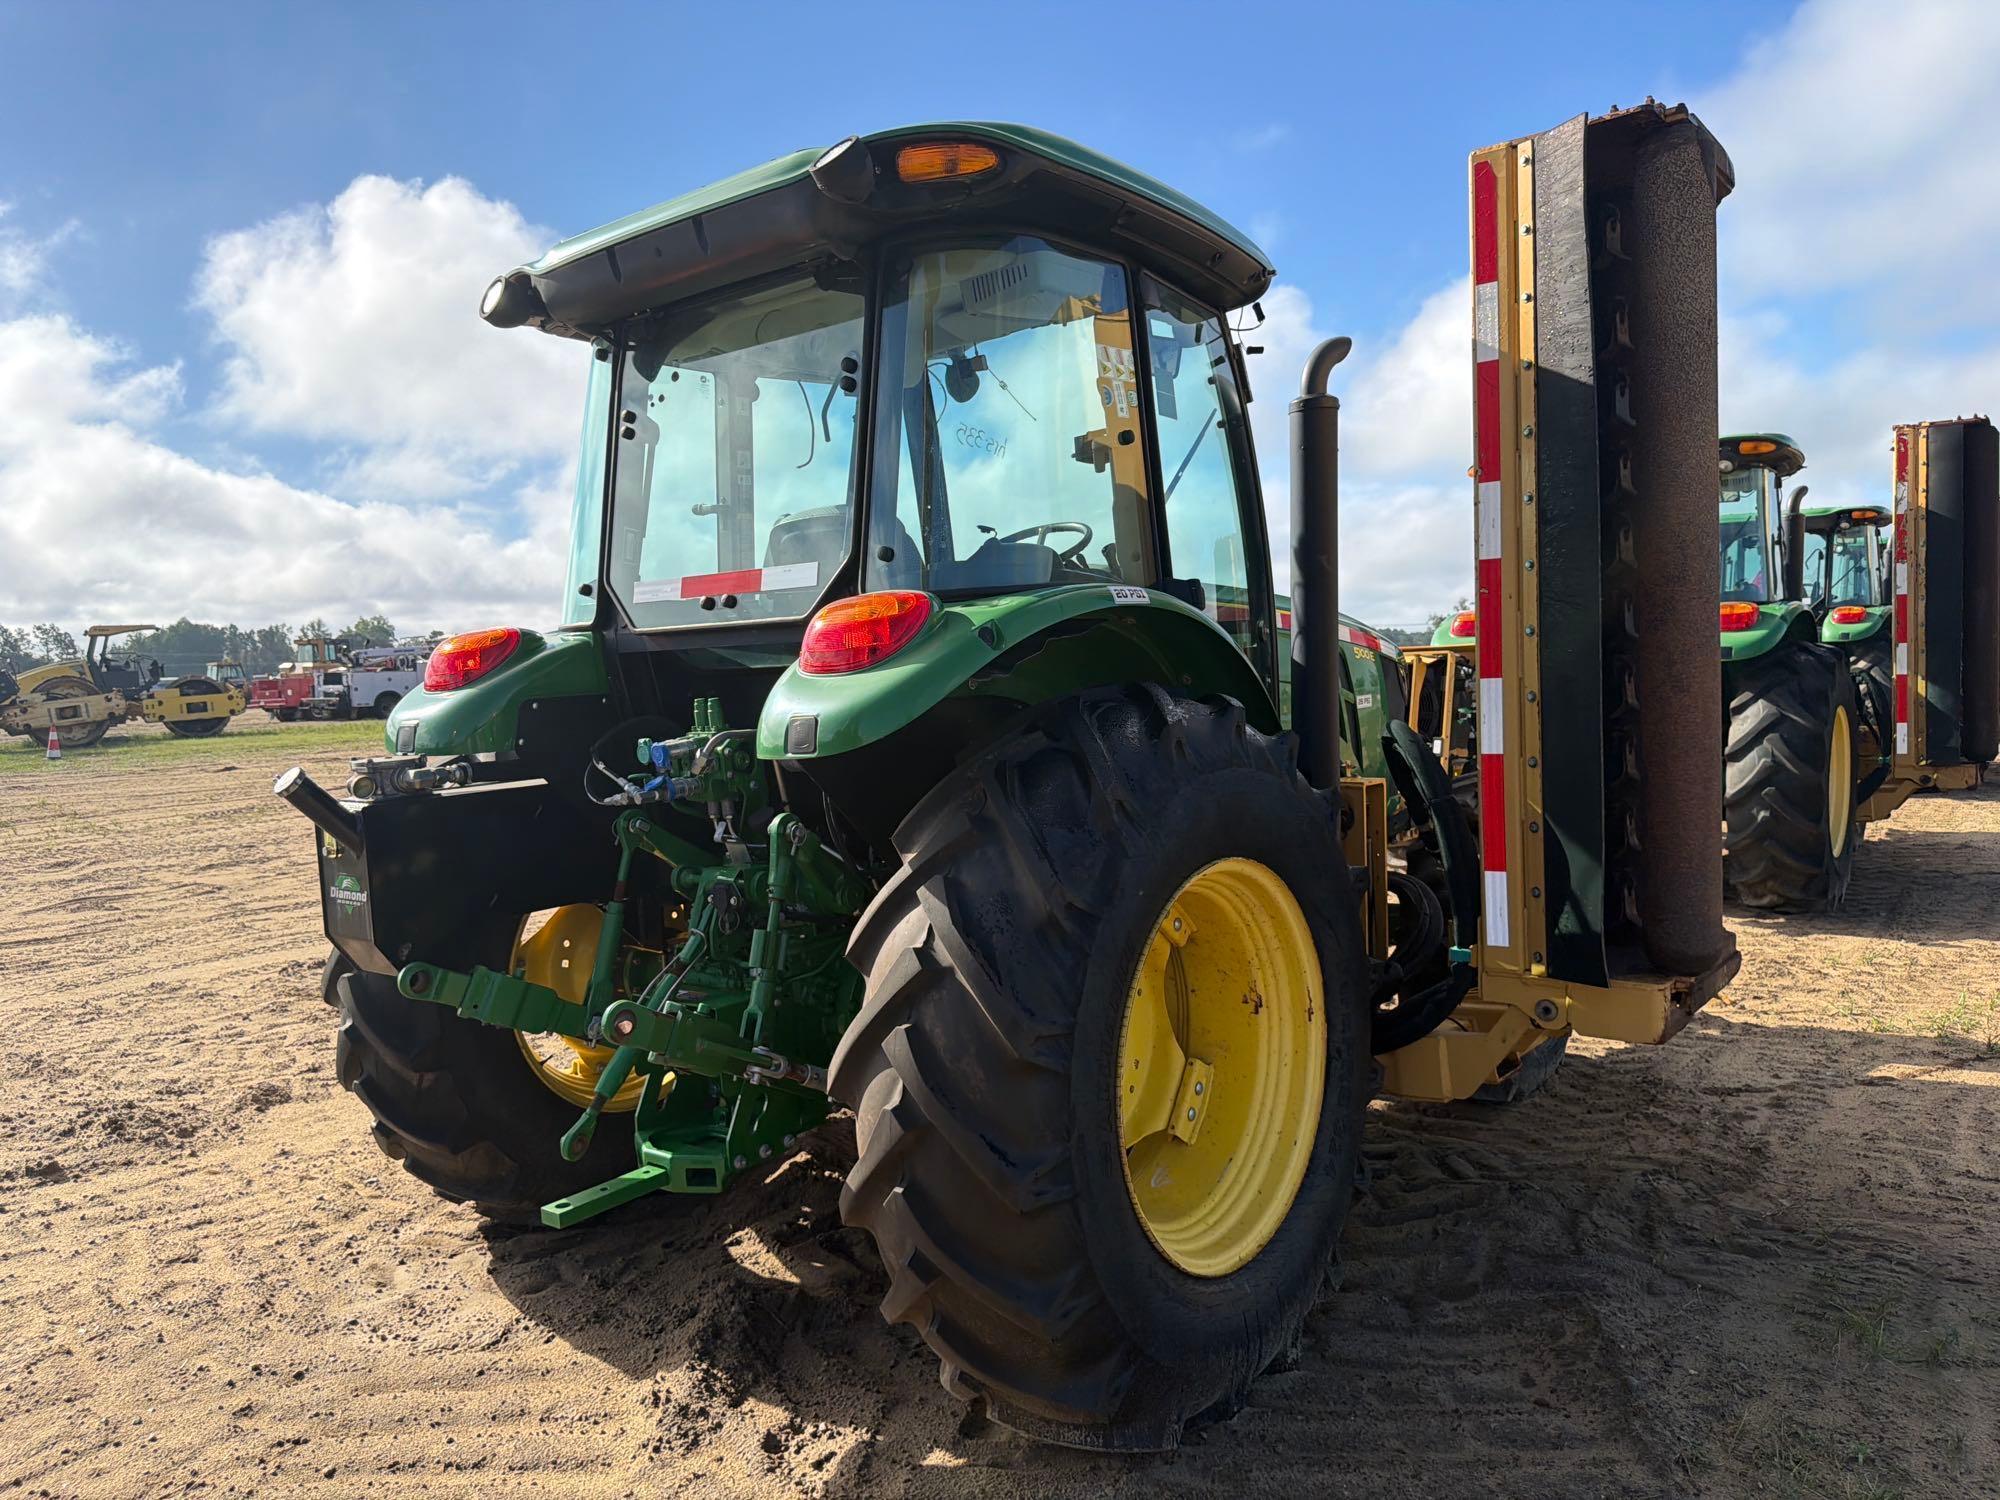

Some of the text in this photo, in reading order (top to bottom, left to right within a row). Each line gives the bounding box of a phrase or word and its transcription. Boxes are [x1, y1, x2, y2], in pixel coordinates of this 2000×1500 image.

[1113, 589, 1146, 598] 20 PSI
[330, 886, 367, 902] Diamond
